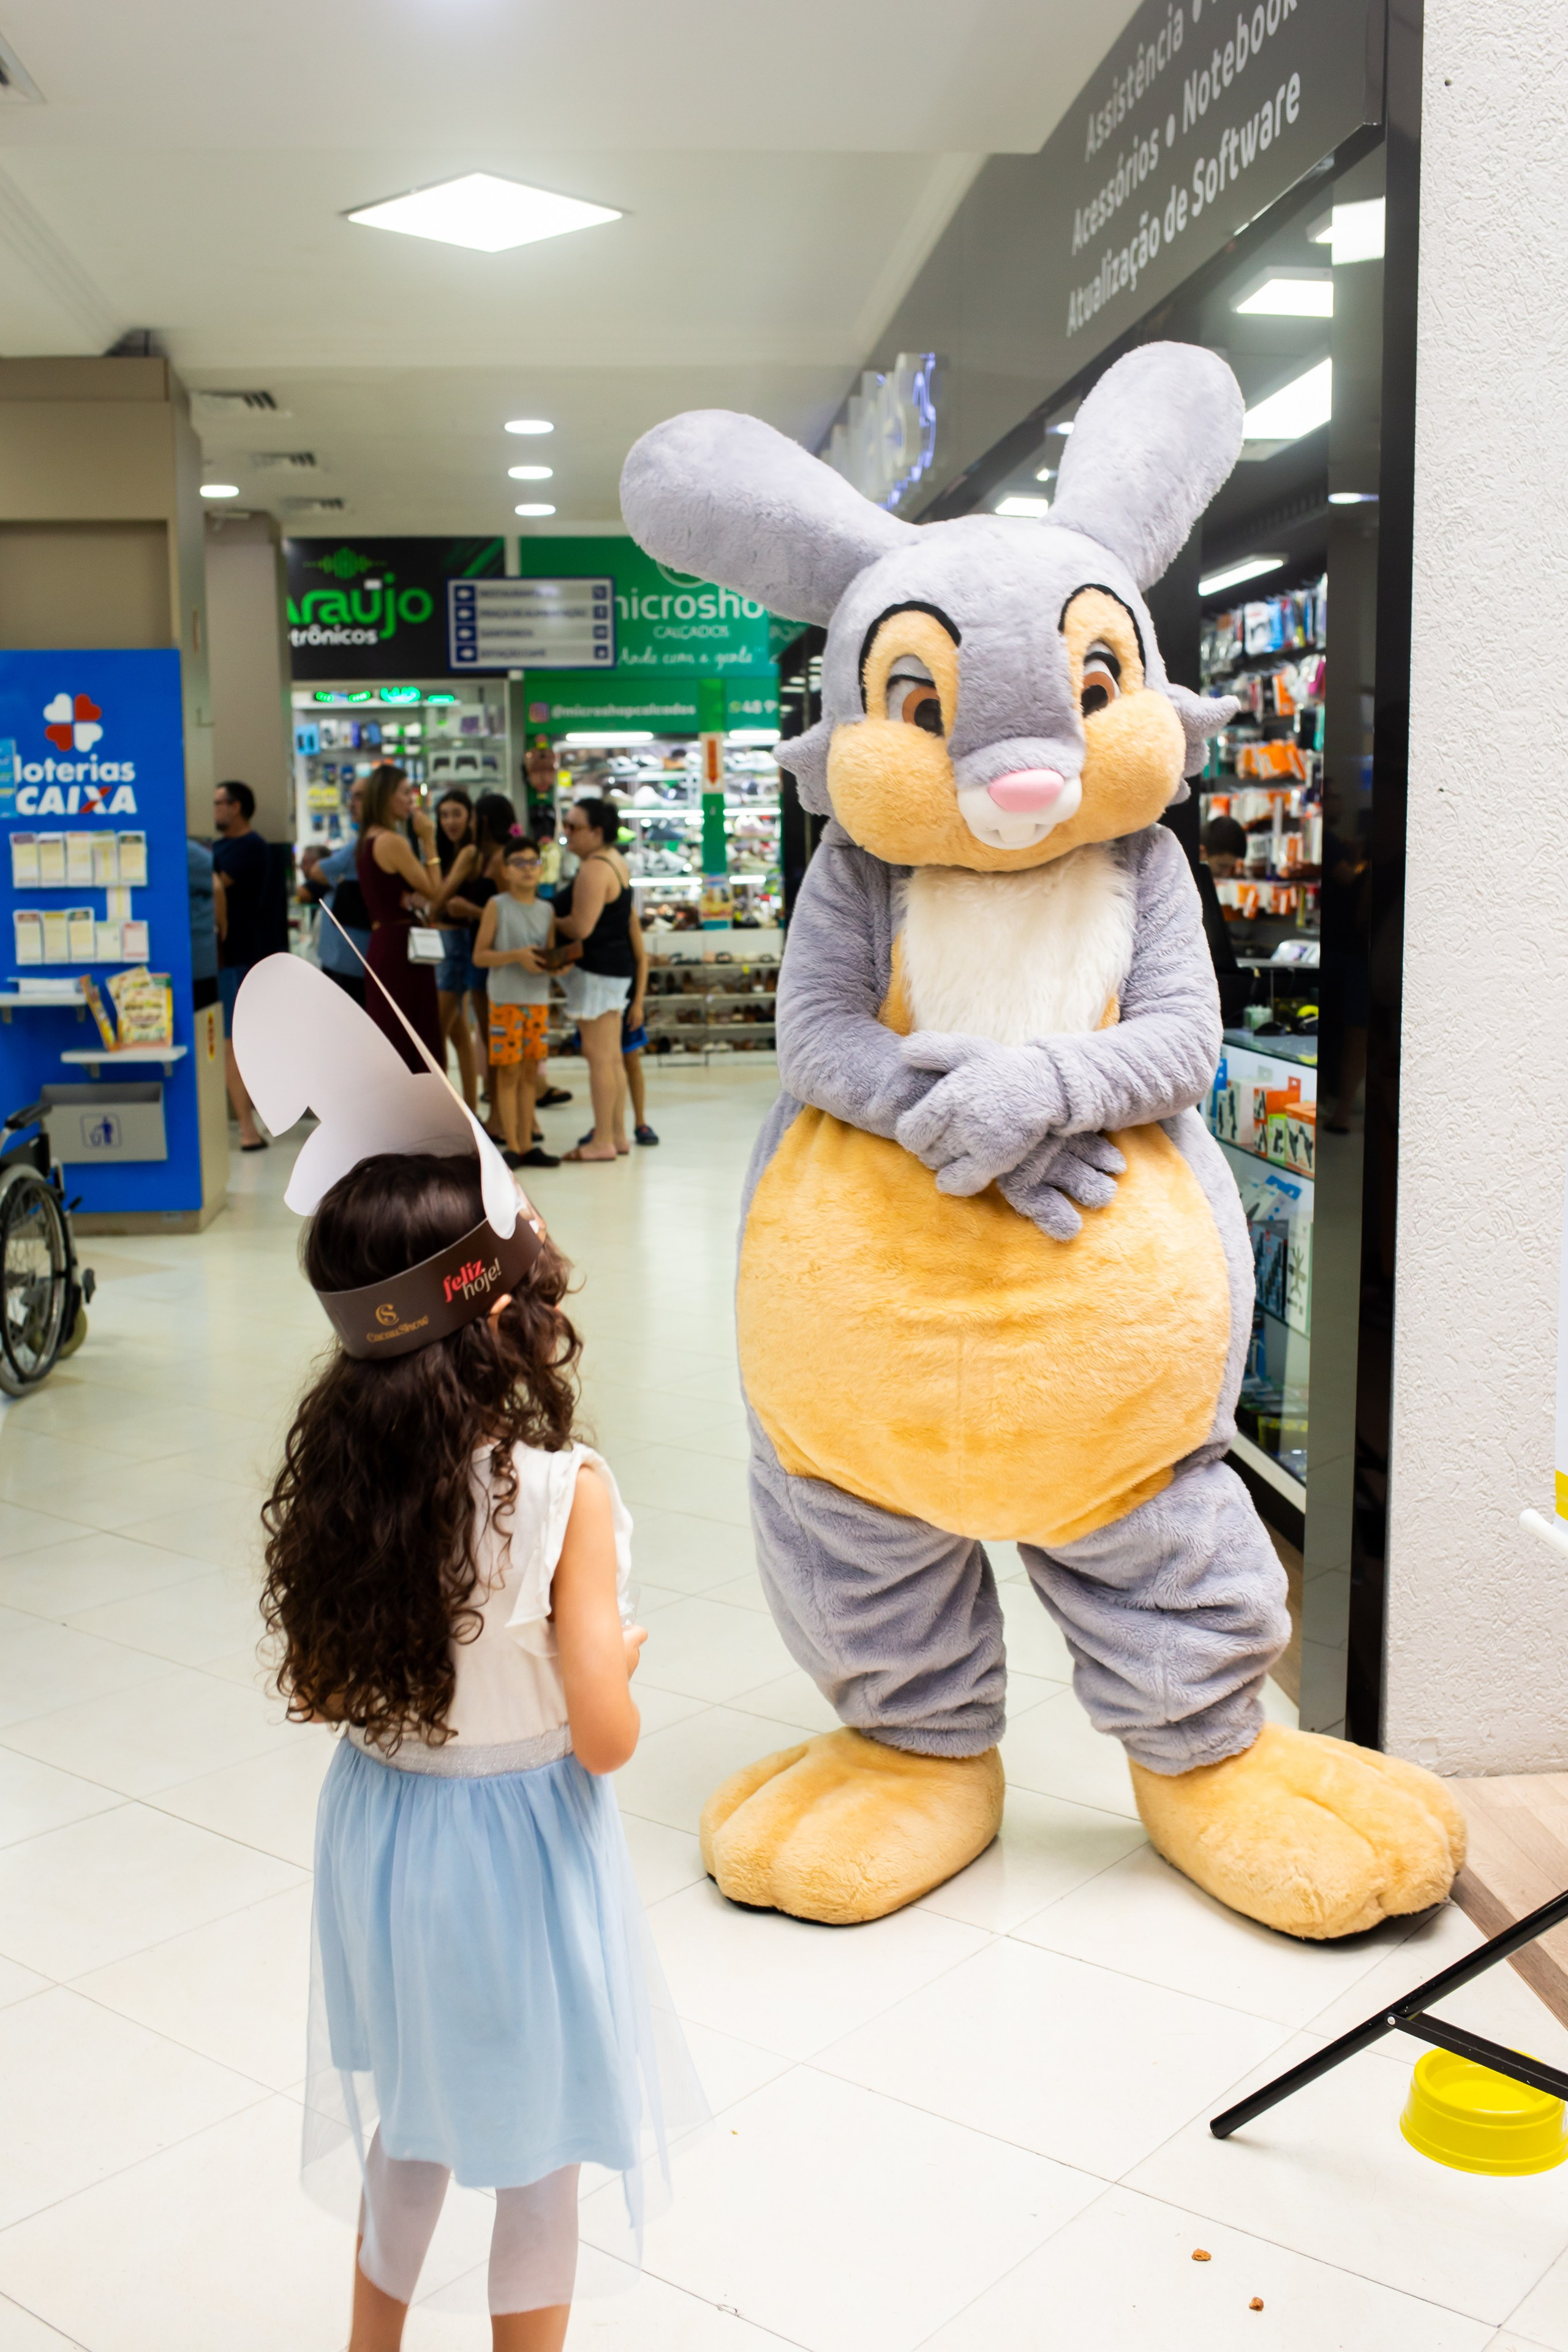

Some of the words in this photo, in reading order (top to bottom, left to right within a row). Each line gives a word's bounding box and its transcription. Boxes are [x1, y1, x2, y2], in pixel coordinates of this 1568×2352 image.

[1085, 3, 1183, 163] Assistência
[1066, 210, 1161, 338] Atualização
[1163, 186, 1188, 244] de
[1191, 72, 1301, 218] Software
[1071, 126, 1159, 256] Acessórios
[288, 624, 379, 648] trônicos
[15, 753, 135, 783] loterias
[16, 785, 137, 815] CAIXA
[443, 1259, 485, 1303] feliz
[462, 1257, 502, 1300] hoje!
